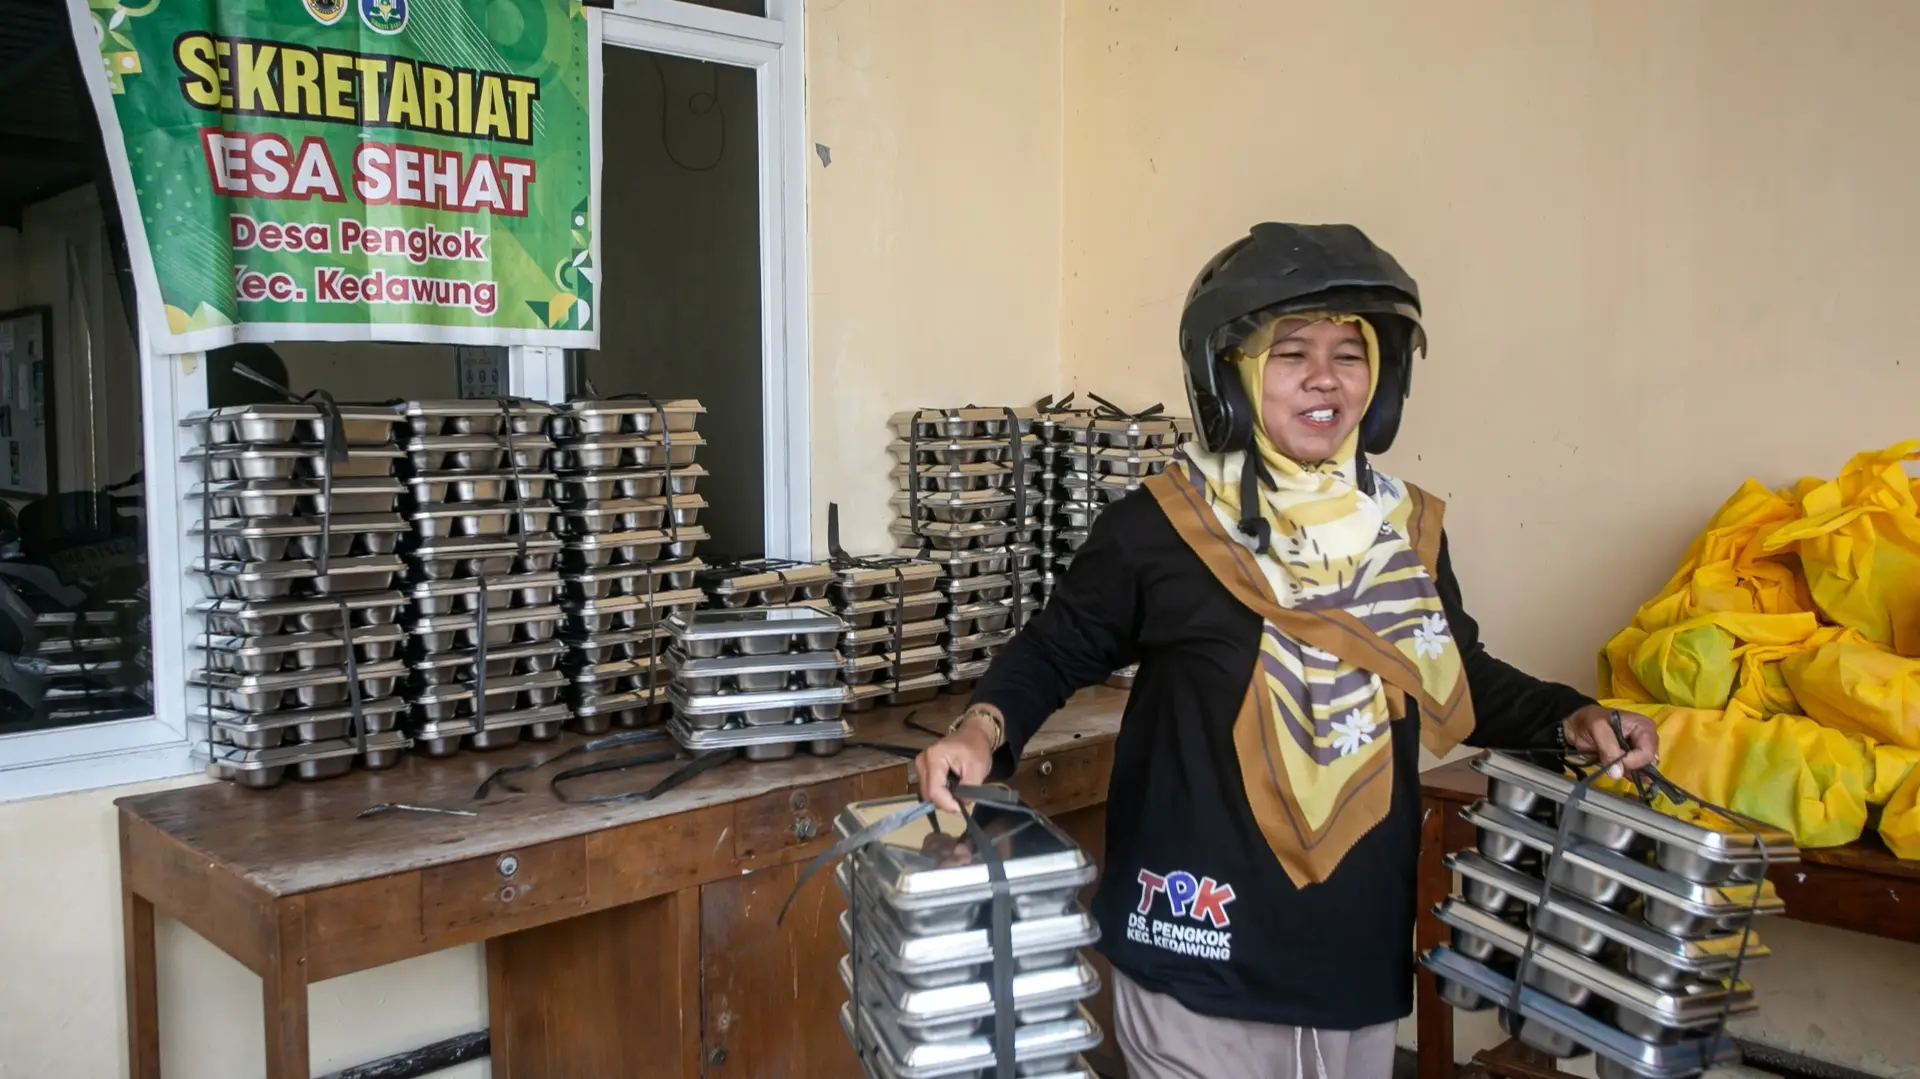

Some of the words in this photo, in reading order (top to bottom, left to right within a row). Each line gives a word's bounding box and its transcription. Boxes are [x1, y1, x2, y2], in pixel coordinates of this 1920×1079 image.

[176, 32, 538, 142] SEKRETARIAT
[355, 143, 533, 213] SEHAT
[230, 215, 329, 251] Desa
[341, 219, 484, 263] Pengkok
[317, 267, 496, 314] Kedawung
[1137, 868, 1236, 929] TPK
[1126, 926, 1153, 945] KEC.
[1154, 934, 1231, 961] KEDAWUNG
[1128, 913, 1150, 932] DS.
[1152, 920, 1232, 948] PENGKOK
